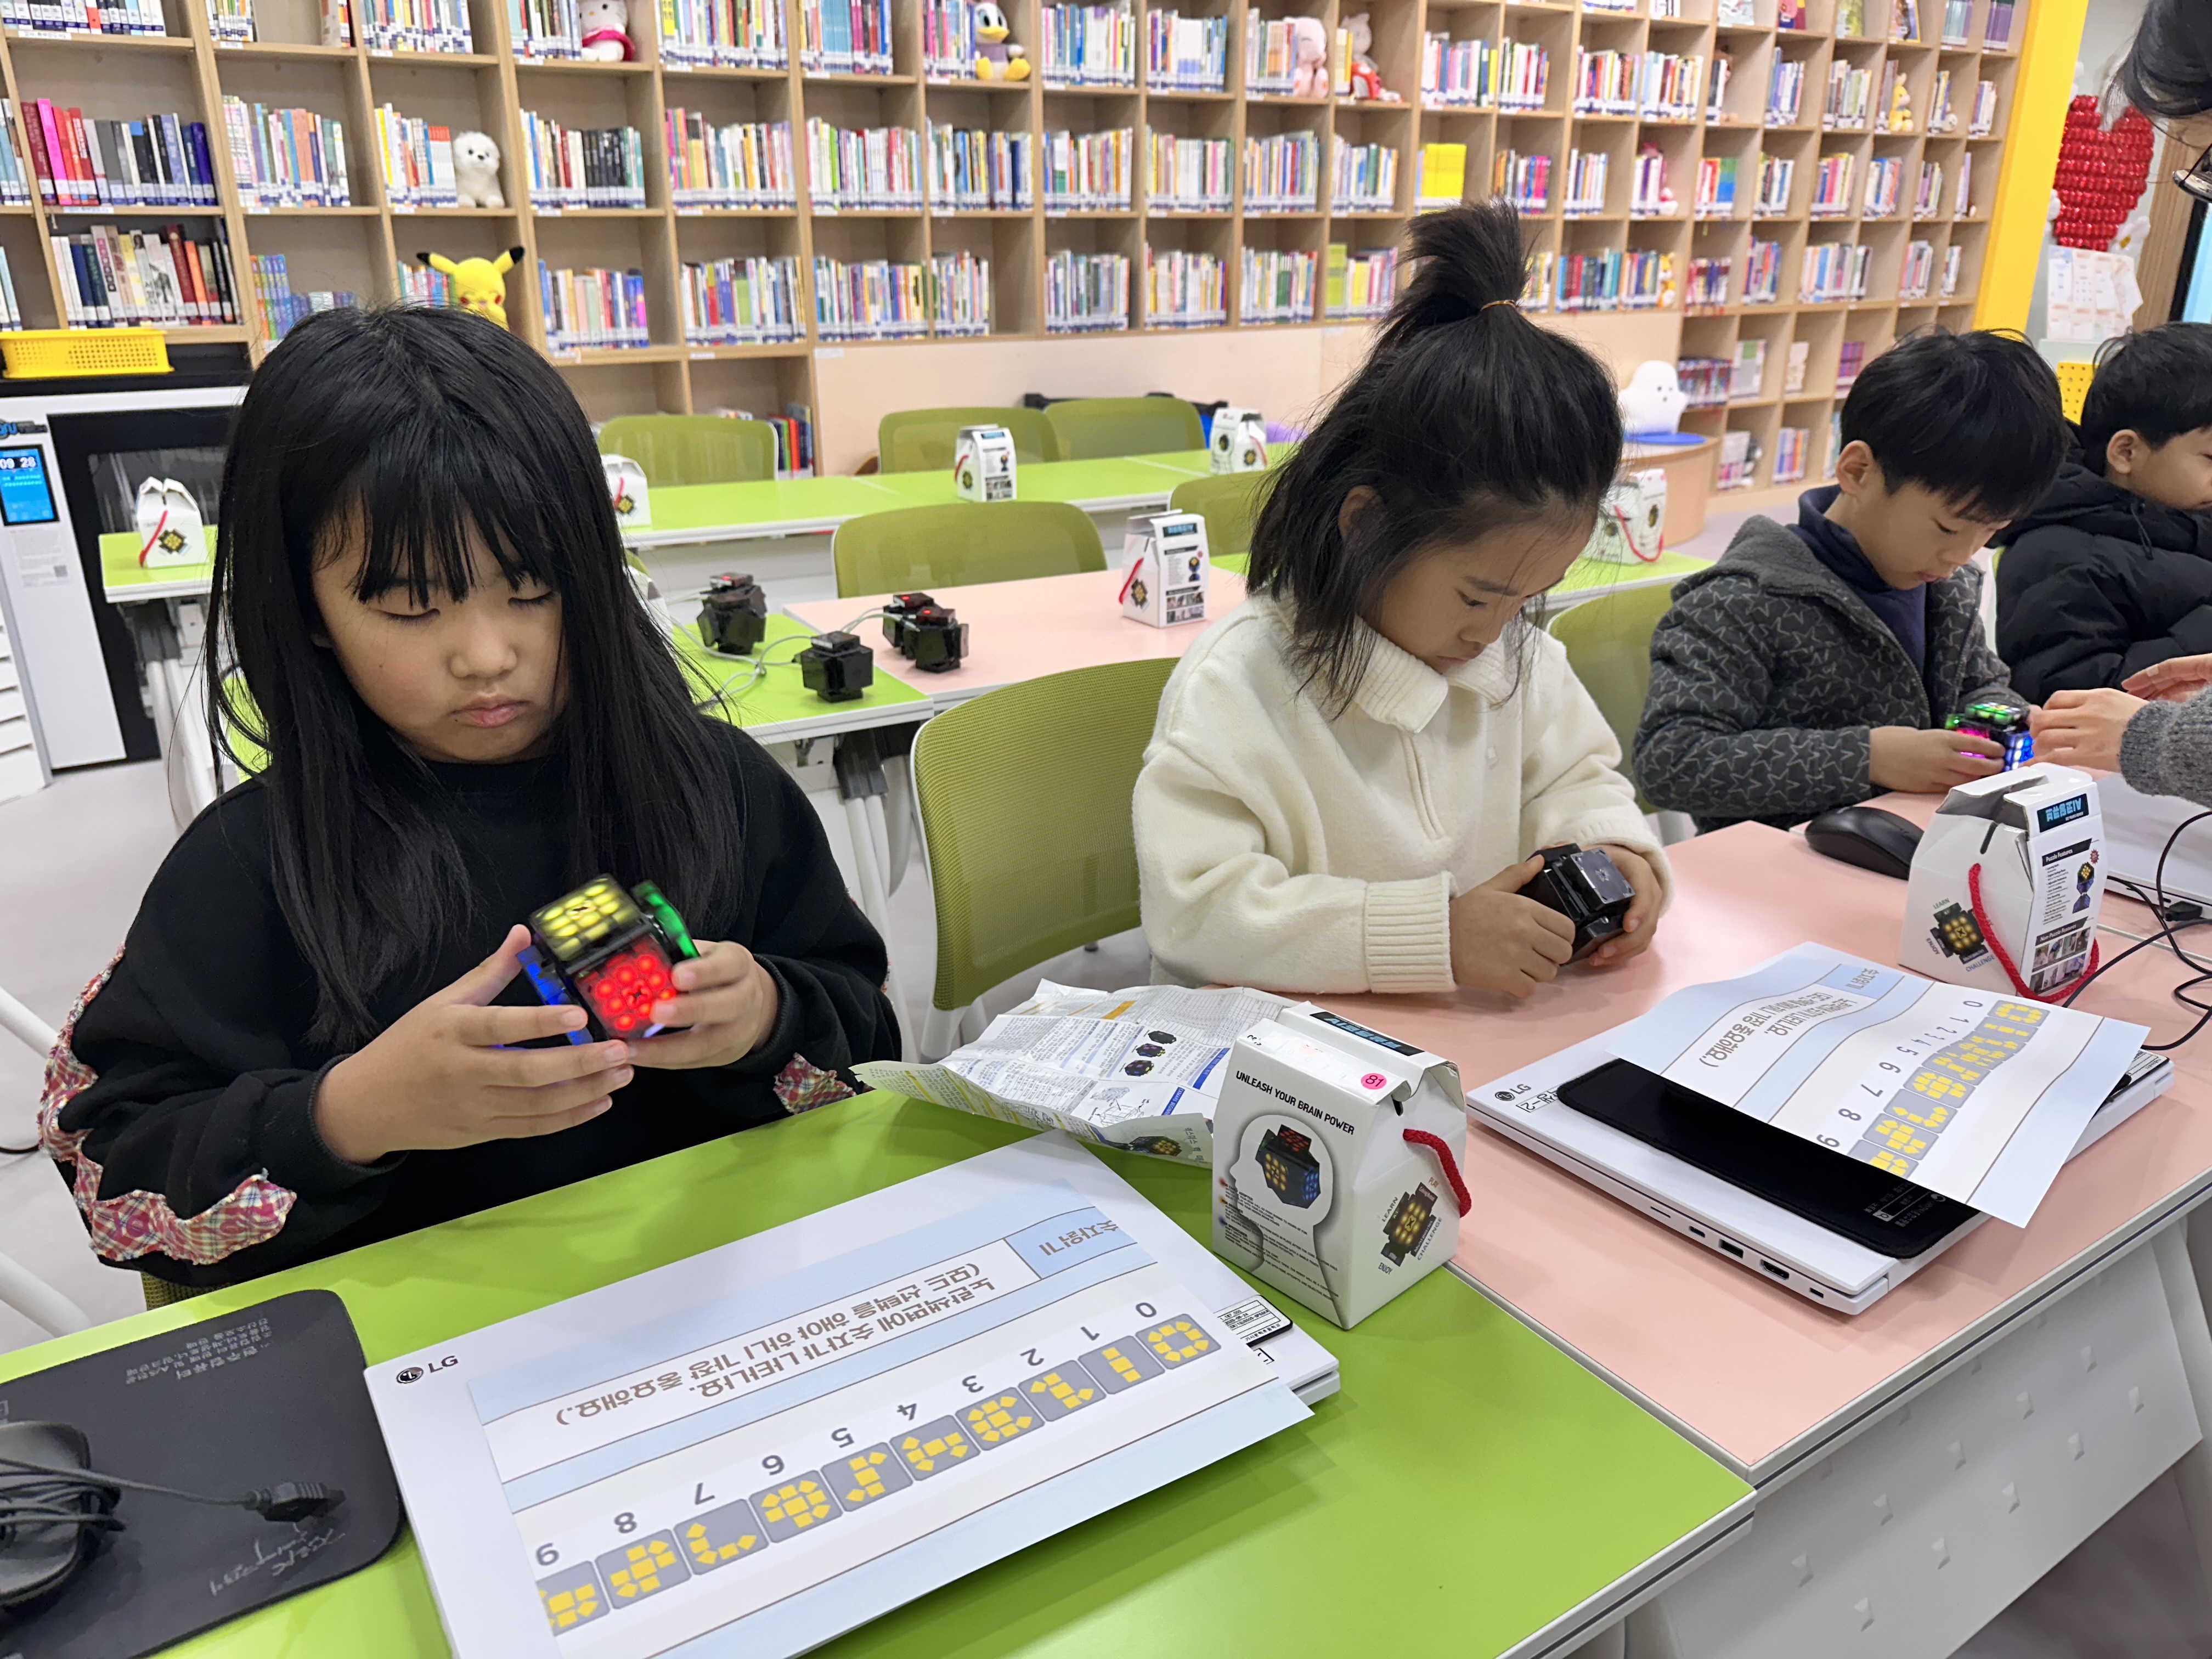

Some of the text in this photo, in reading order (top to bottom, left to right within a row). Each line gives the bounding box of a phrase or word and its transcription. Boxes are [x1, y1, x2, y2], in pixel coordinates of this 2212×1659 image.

[1933, 898, 1950, 909] LEARN
[1926, 938, 1940, 955] ENJOY
[1966, 955, 1995, 972] CHALLENGE
[1699, 1024, 1755, 1067] 중요해요.)
[1897, 1046, 1918, 1056] 5
[1878, 1062, 1901, 1073] 6
[1365, 1075, 1385, 1087] 81
[1510, 1084, 1532, 1094] LG
[1861, 1084, 1883, 1097] 7
[1236, 1070, 1355, 1135] UNLEASH YOUR BRAIN POWER
[1838, 1109, 1861, 1121] 8
[1816, 1135, 1840, 1147] 9
[1429, 1177, 1439, 1188] PLAY
[1382, 1197, 1398, 1222] LEARN
[1039, 1220, 1119, 1256] 숫자읽기
[1418, 1217, 1442, 1260] CHALLENGE
[1378, 1262, 1393, 1274] ENJOY
[1136, 1302, 1157, 1318] 0
[689, 1278, 995, 1397] 노란색면에 숫자가 나타나요.
[1080, 1327, 1101, 1341] 1
[556, 1263, 980, 1426] (모드 선택을 해야 하니 가장 중요해요.)
[427, 1355, 459, 1374] LG
[1020, 1348, 1045, 1366] 2
[962, 1375, 984, 1393] 3
[896, 1403, 917, 1420] 4
[831, 1427, 855, 1448] 5
[761, 1455, 785, 1475] 6
[695, 1483, 715, 1505] 7
[614, 1513, 636, 1533] 8
[537, 1543, 558, 1565] 9
